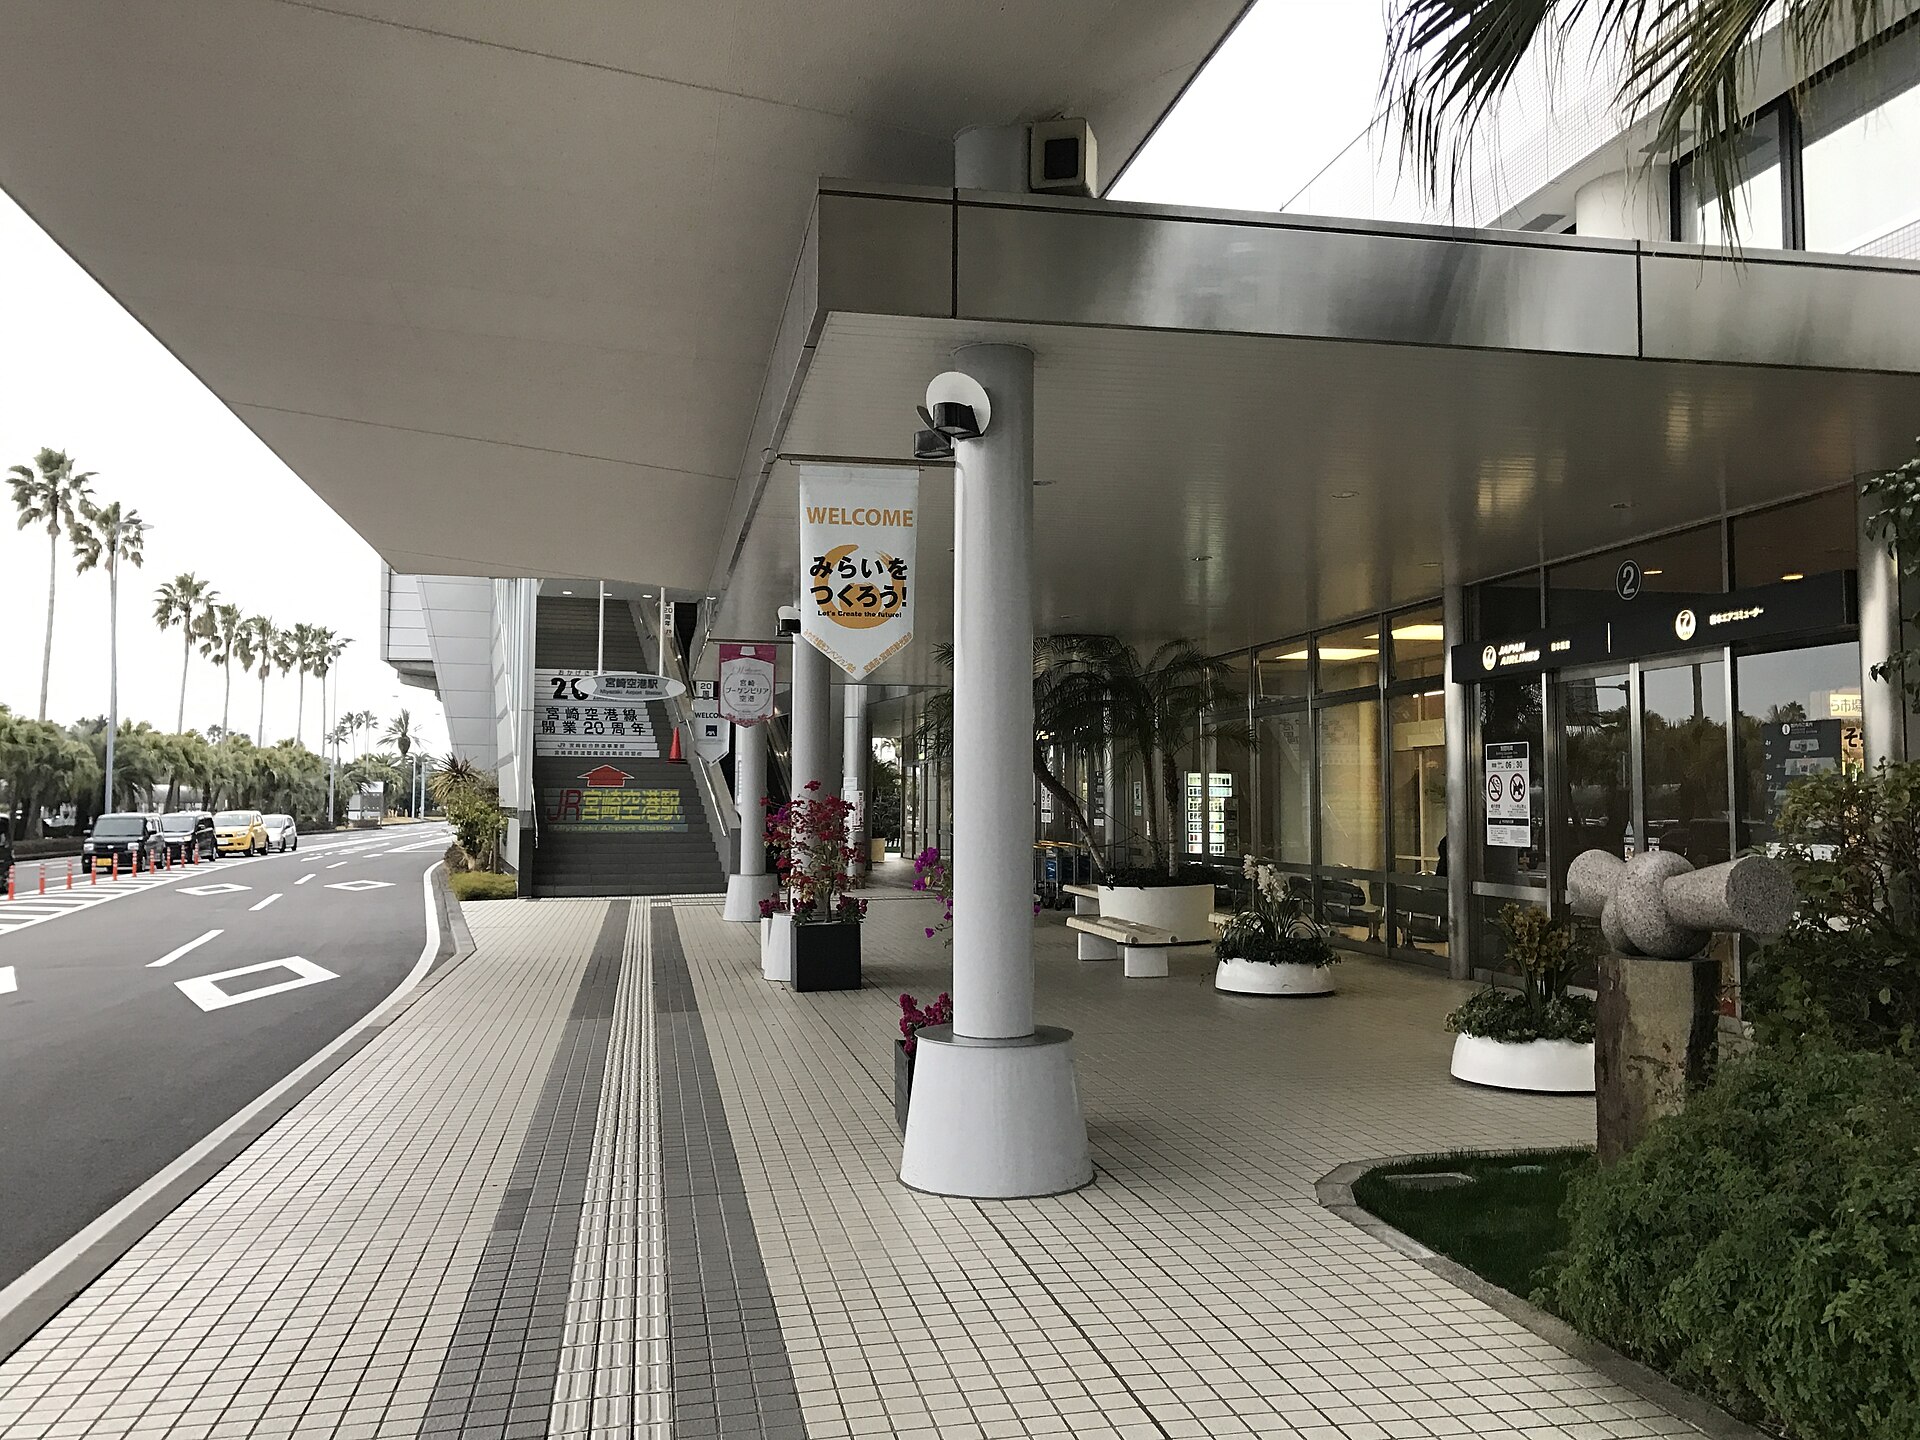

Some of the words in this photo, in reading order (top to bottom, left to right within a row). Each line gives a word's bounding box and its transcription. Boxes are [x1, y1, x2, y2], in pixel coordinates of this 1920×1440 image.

[806, 506, 914, 528] WELCOME
[809, 555, 908, 580] みらいを
[1622, 565, 1635, 595] 2
[810, 585, 908, 609] つくろう!
[877, 611, 902, 619] future!
[1498, 641, 1526, 656] JAPAN
[1500, 650, 1541, 666] AIRLINES
[605, 677, 659, 689] 宮崎空港駅
[739, 679, 756, 687] 宮崎
[725, 687, 769, 695] ブーゲンビリア
[739, 695, 755, 703] 空港
[546, 706, 638, 722] 宮崎空港線
[541, 720, 646, 736] 開業20周年
[552, 825, 599, 833] Miyazaki
[638, 824, 675, 832] Station
